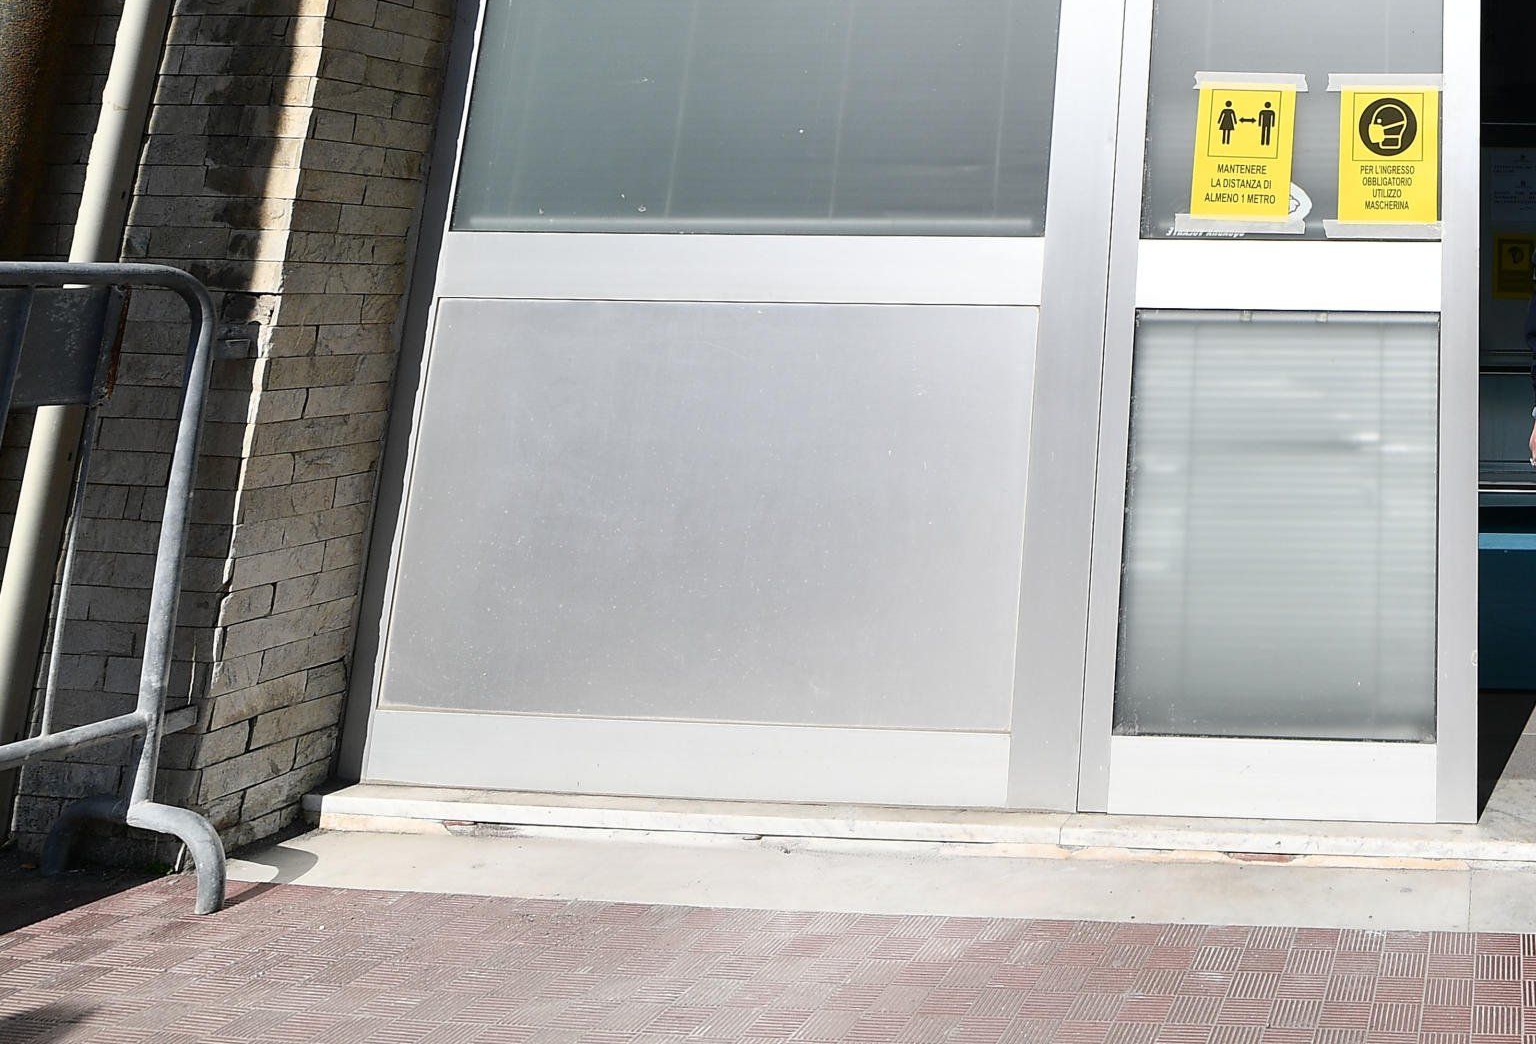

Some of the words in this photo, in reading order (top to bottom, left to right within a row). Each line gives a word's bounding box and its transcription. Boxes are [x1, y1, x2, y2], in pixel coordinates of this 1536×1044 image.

[1217, 164, 1267, 174] MANTENERE
[1360, 165, 1374, 175] PER
[1375, 165, 1415, 175] L'INGRESSO
[1210, 178, 1222, 188] LA
[1223, 178, 1261, 189] DISTANZA
[1263, 179, 1272, 189] DI
[1362, 177, 1413, 186] OBBLIGATORIO
[1204, 192, 1239, 203] ALMENO
[1247, 194, 1276, 204] METRO
[1372, 188, 1402, 198] UTILIZZO
[1365, 200, 1409, 210] MASCHERINA
